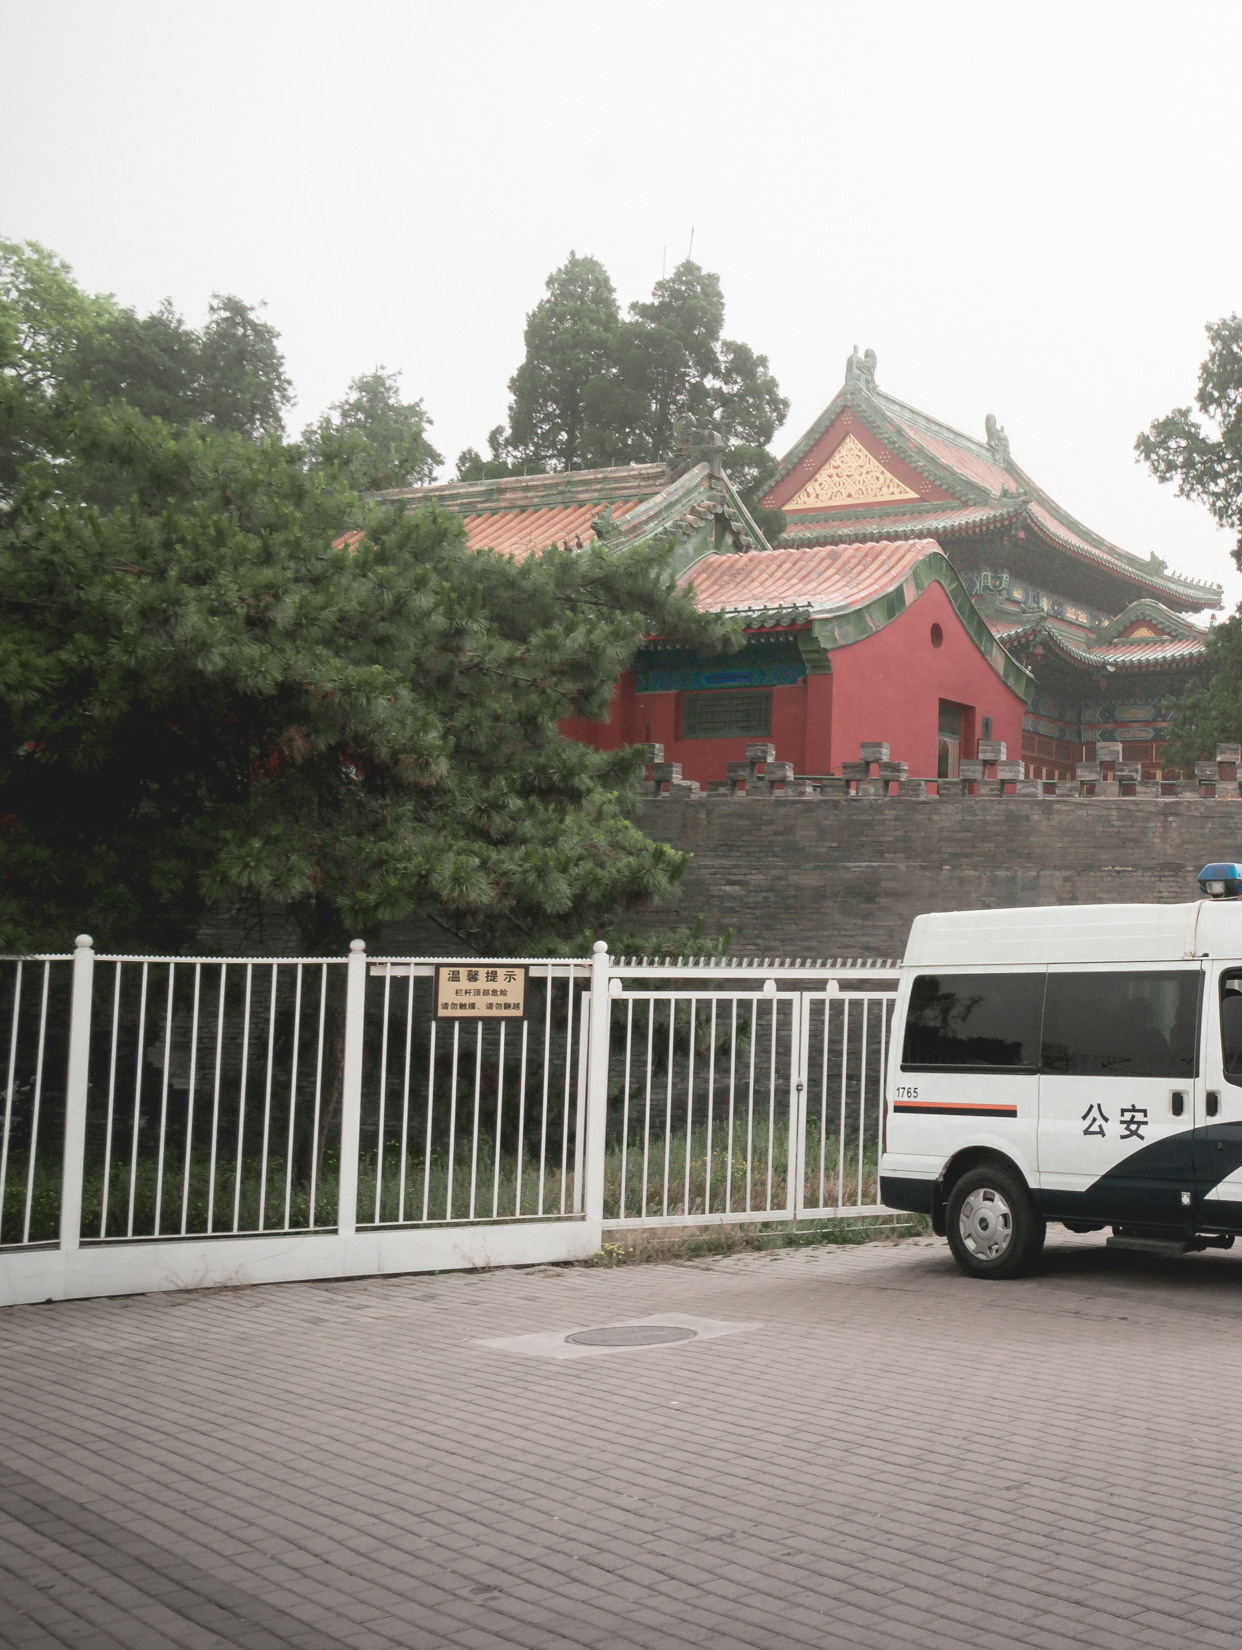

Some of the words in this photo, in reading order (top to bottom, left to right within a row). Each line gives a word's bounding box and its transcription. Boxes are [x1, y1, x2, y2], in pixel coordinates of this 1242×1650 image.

[447, 970, 517, 983] 温馨提示
[454, 988, 509, 997] 栏杆顶部危险
[896, 1086, 919, 1099] 1765
[1081, 1102, 1149, 1141] 公安
